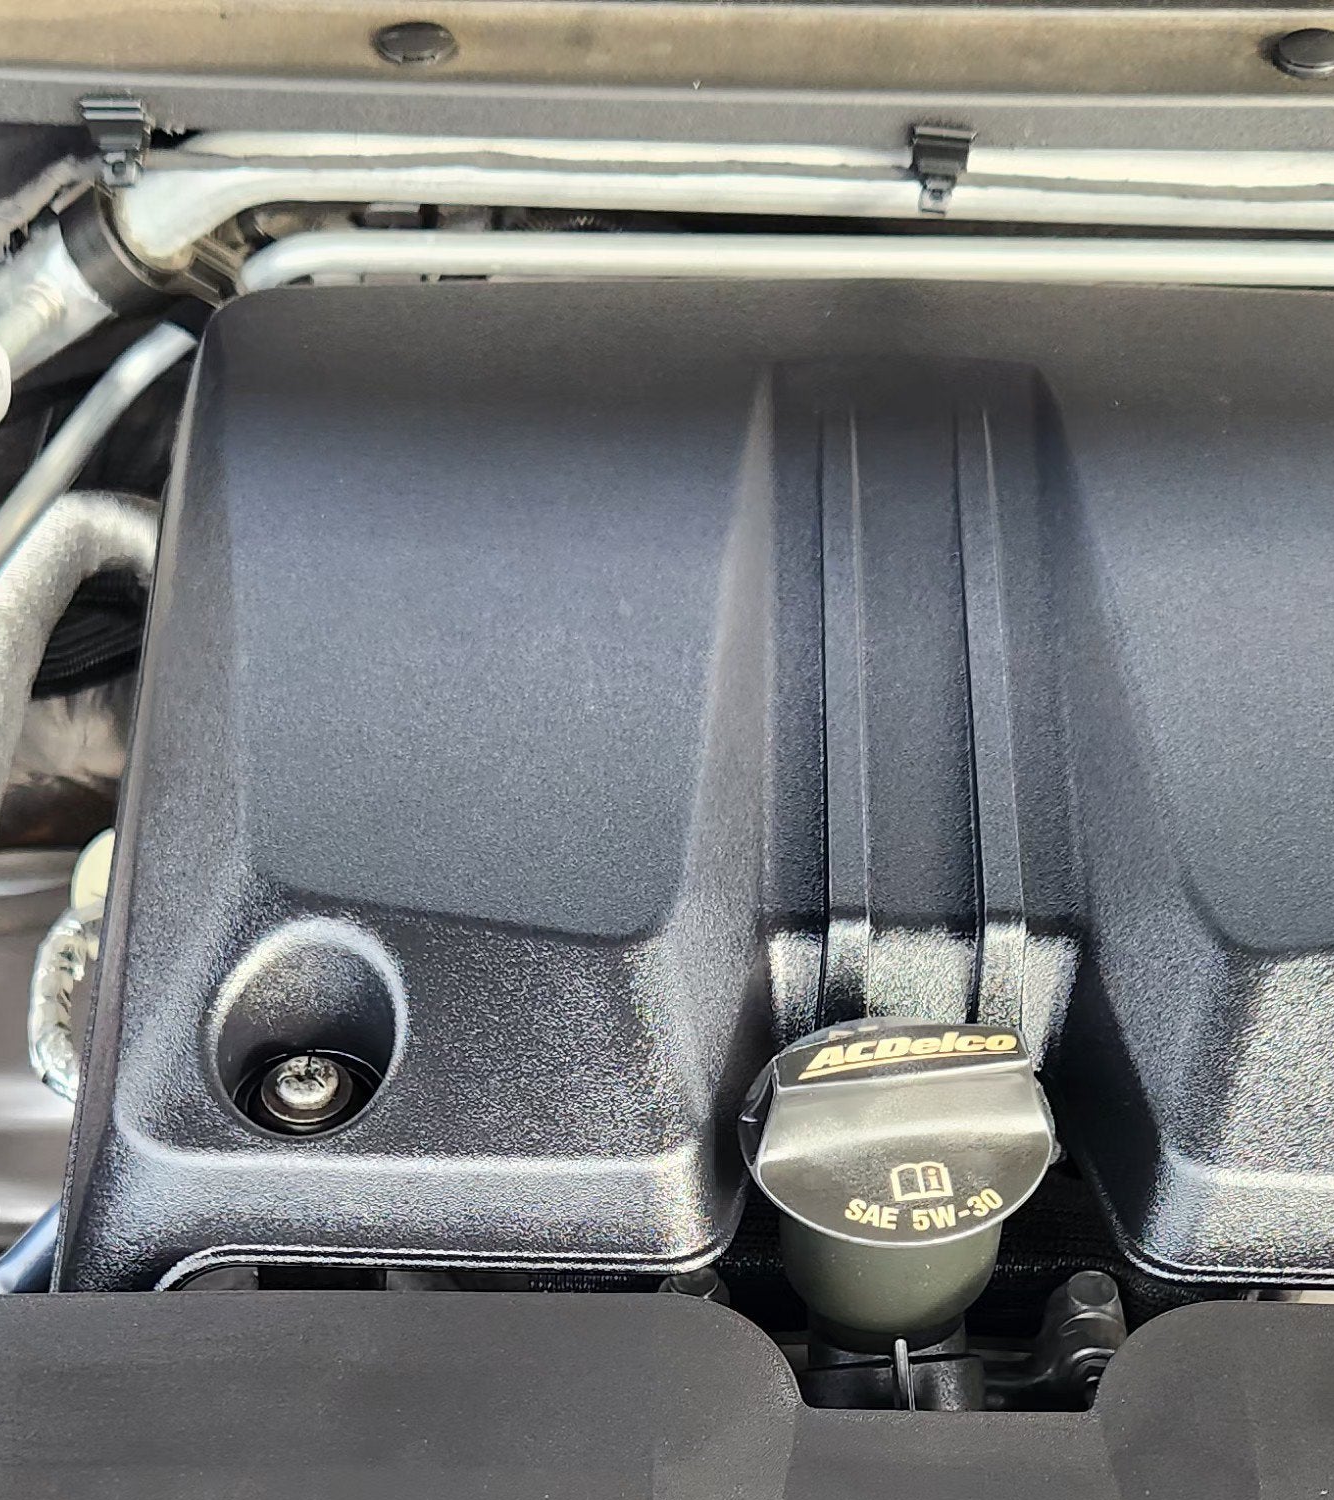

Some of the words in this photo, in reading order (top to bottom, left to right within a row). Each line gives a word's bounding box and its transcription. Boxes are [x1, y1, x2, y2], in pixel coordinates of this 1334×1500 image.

[805, 1031, 1018, 1071] ACDelco
[844, 1198, 899, 1230] SAE
[912, 1188, 1004, 1232] 5W-30
